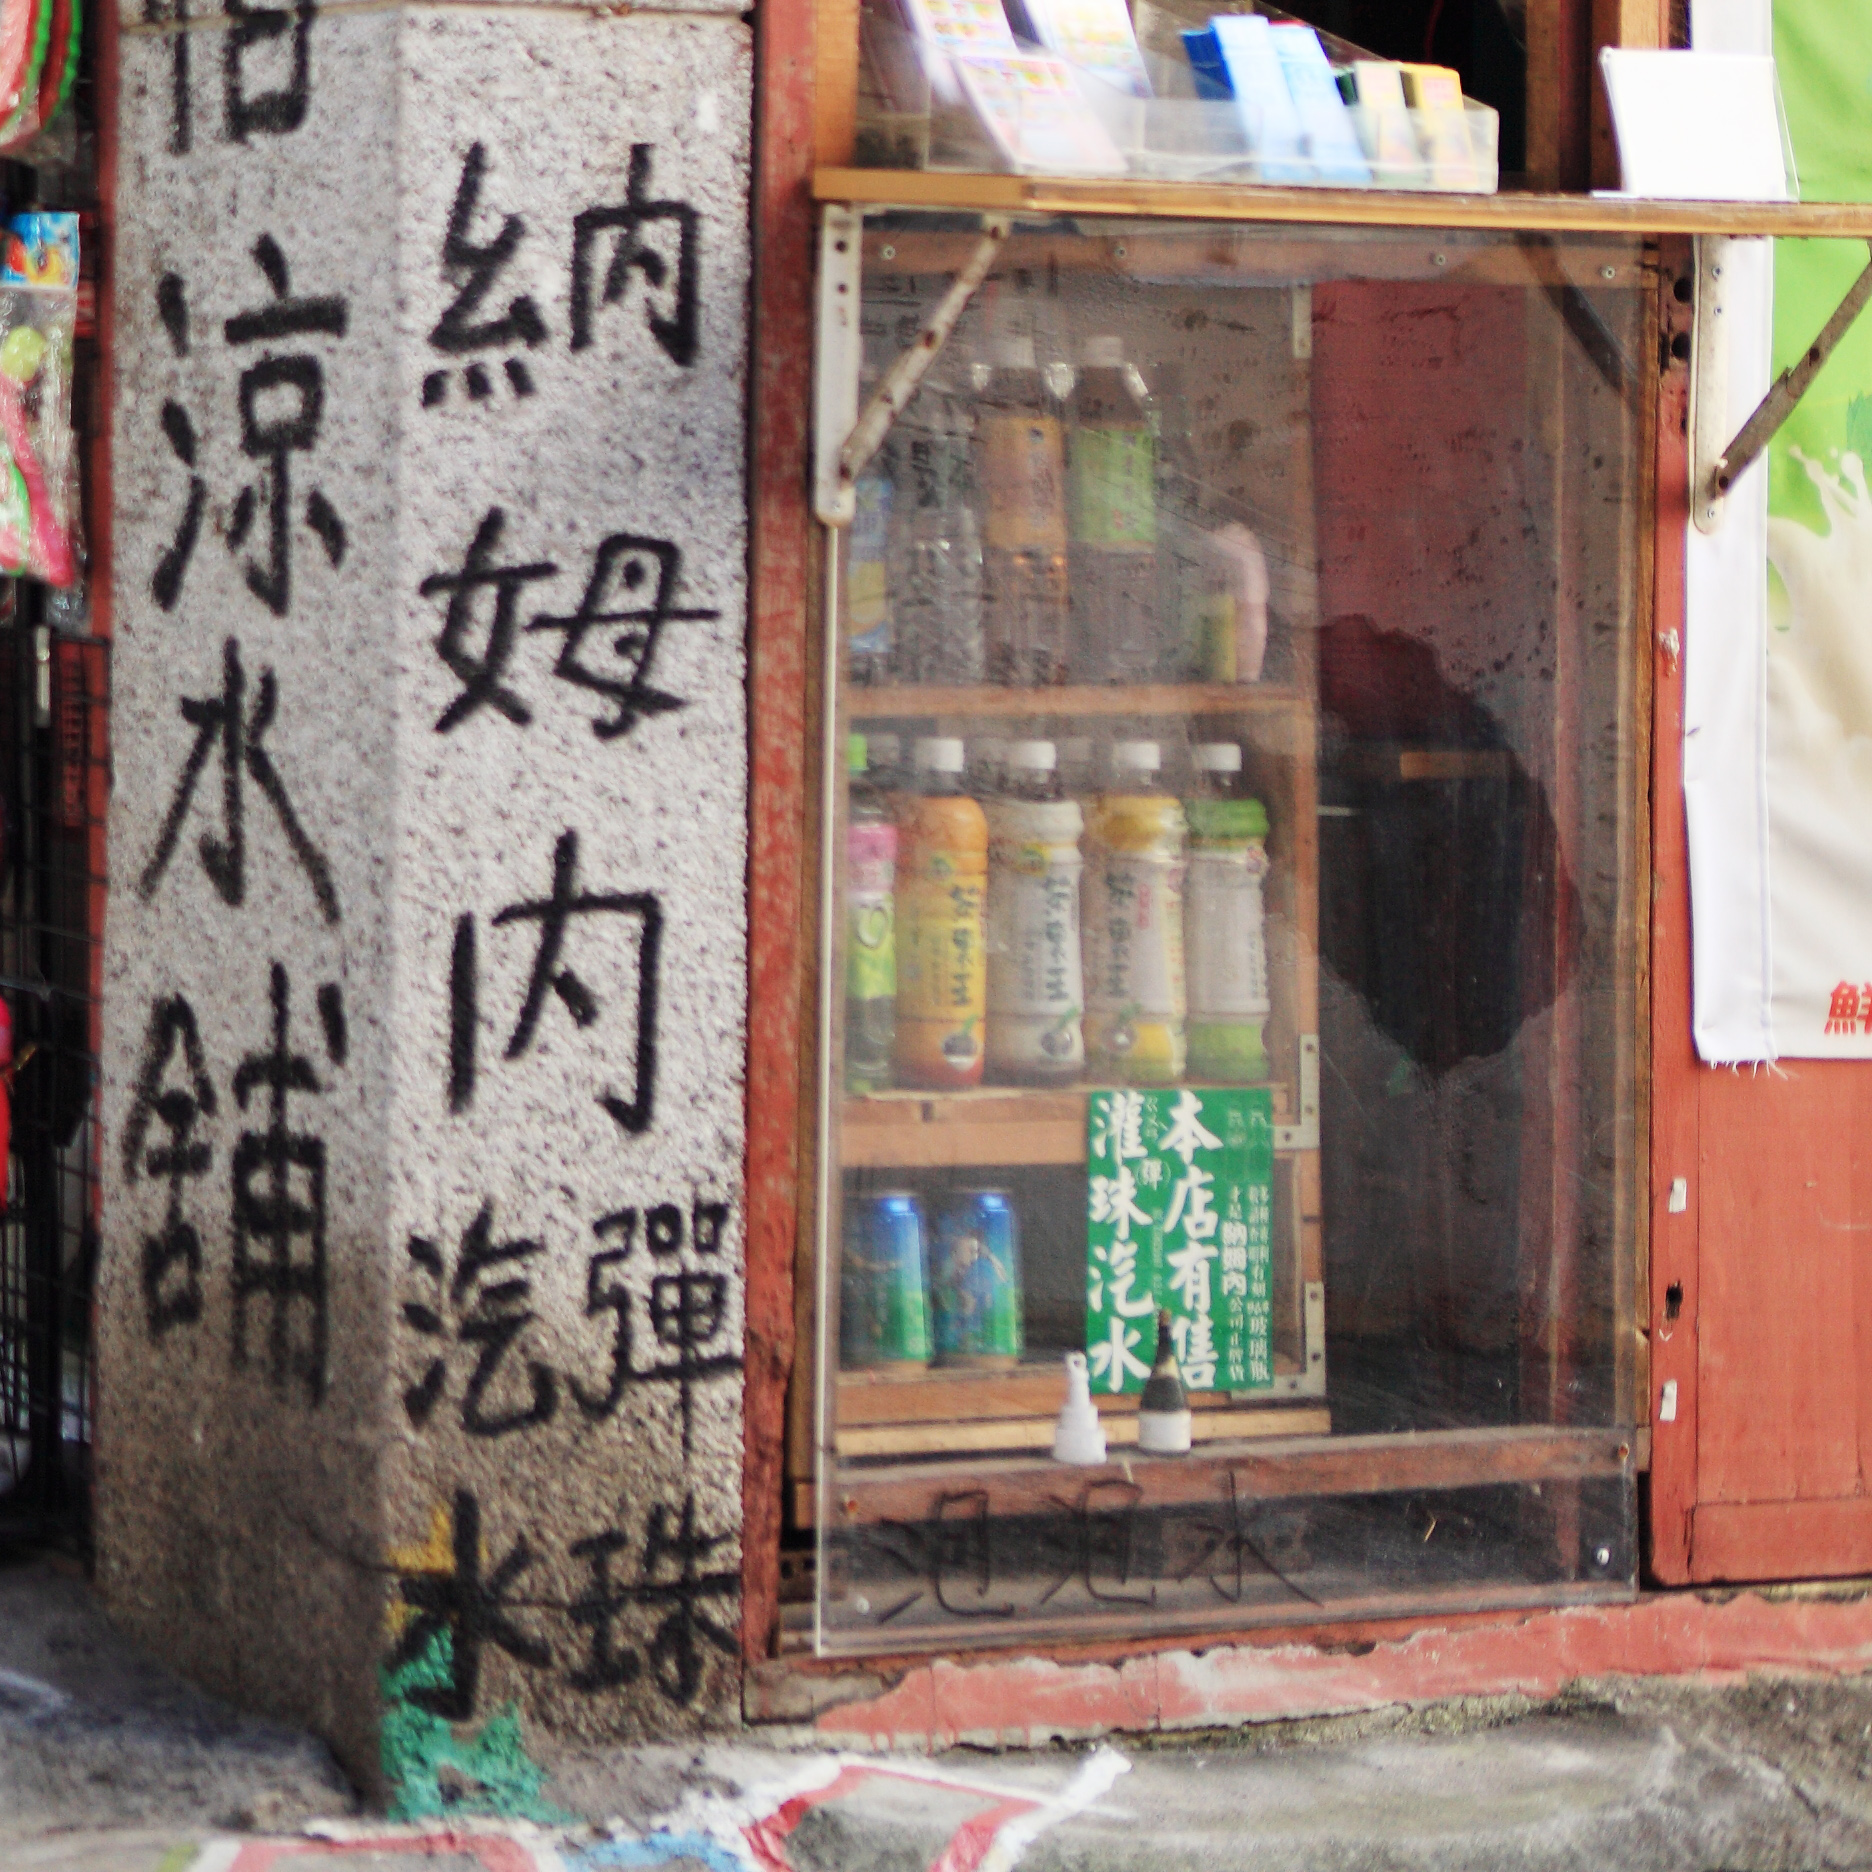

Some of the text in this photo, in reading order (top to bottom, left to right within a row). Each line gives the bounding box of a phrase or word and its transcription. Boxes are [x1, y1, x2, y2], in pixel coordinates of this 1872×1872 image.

[1088, 1089, 1154, 1394] 灌珠汽水
[1158, 1088, 1224, 1389] 本店有售
